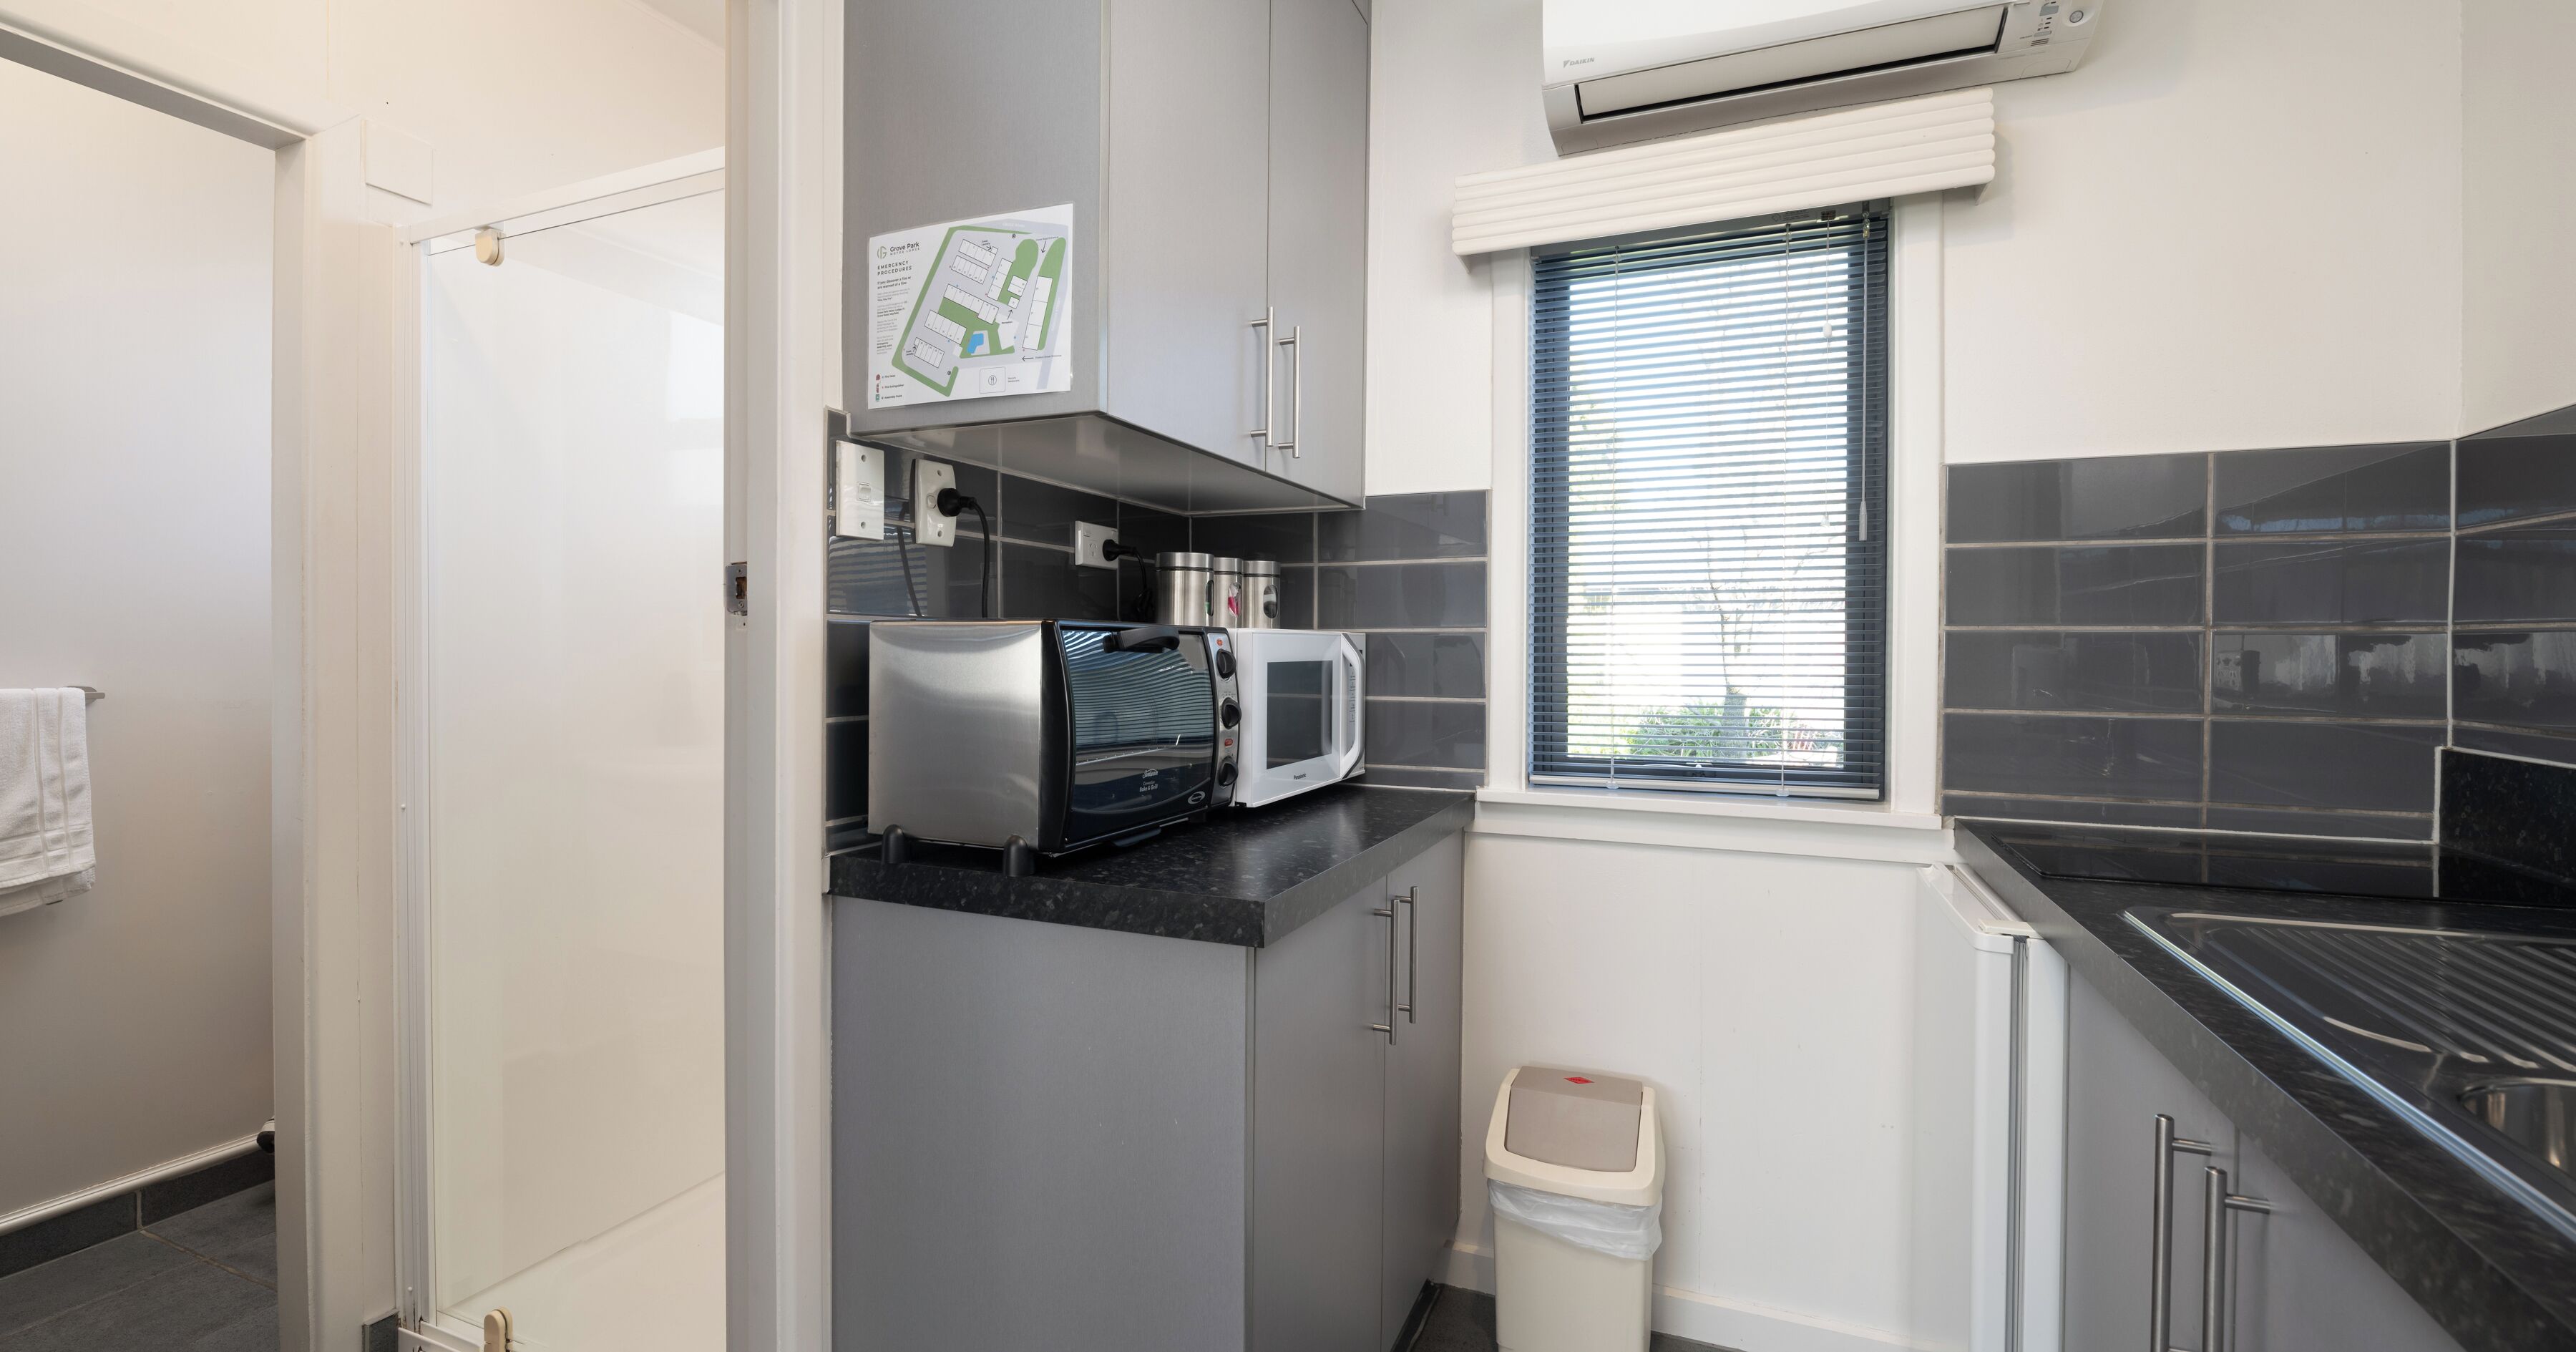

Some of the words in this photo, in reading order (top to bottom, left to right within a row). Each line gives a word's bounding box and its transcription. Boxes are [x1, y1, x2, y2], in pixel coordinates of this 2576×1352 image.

[1569, 57, 1595, 66] DAIKIN
[877, 261, 909, 270] EMERGENCY
[877, 266, 912, 276] PROCEDURES
